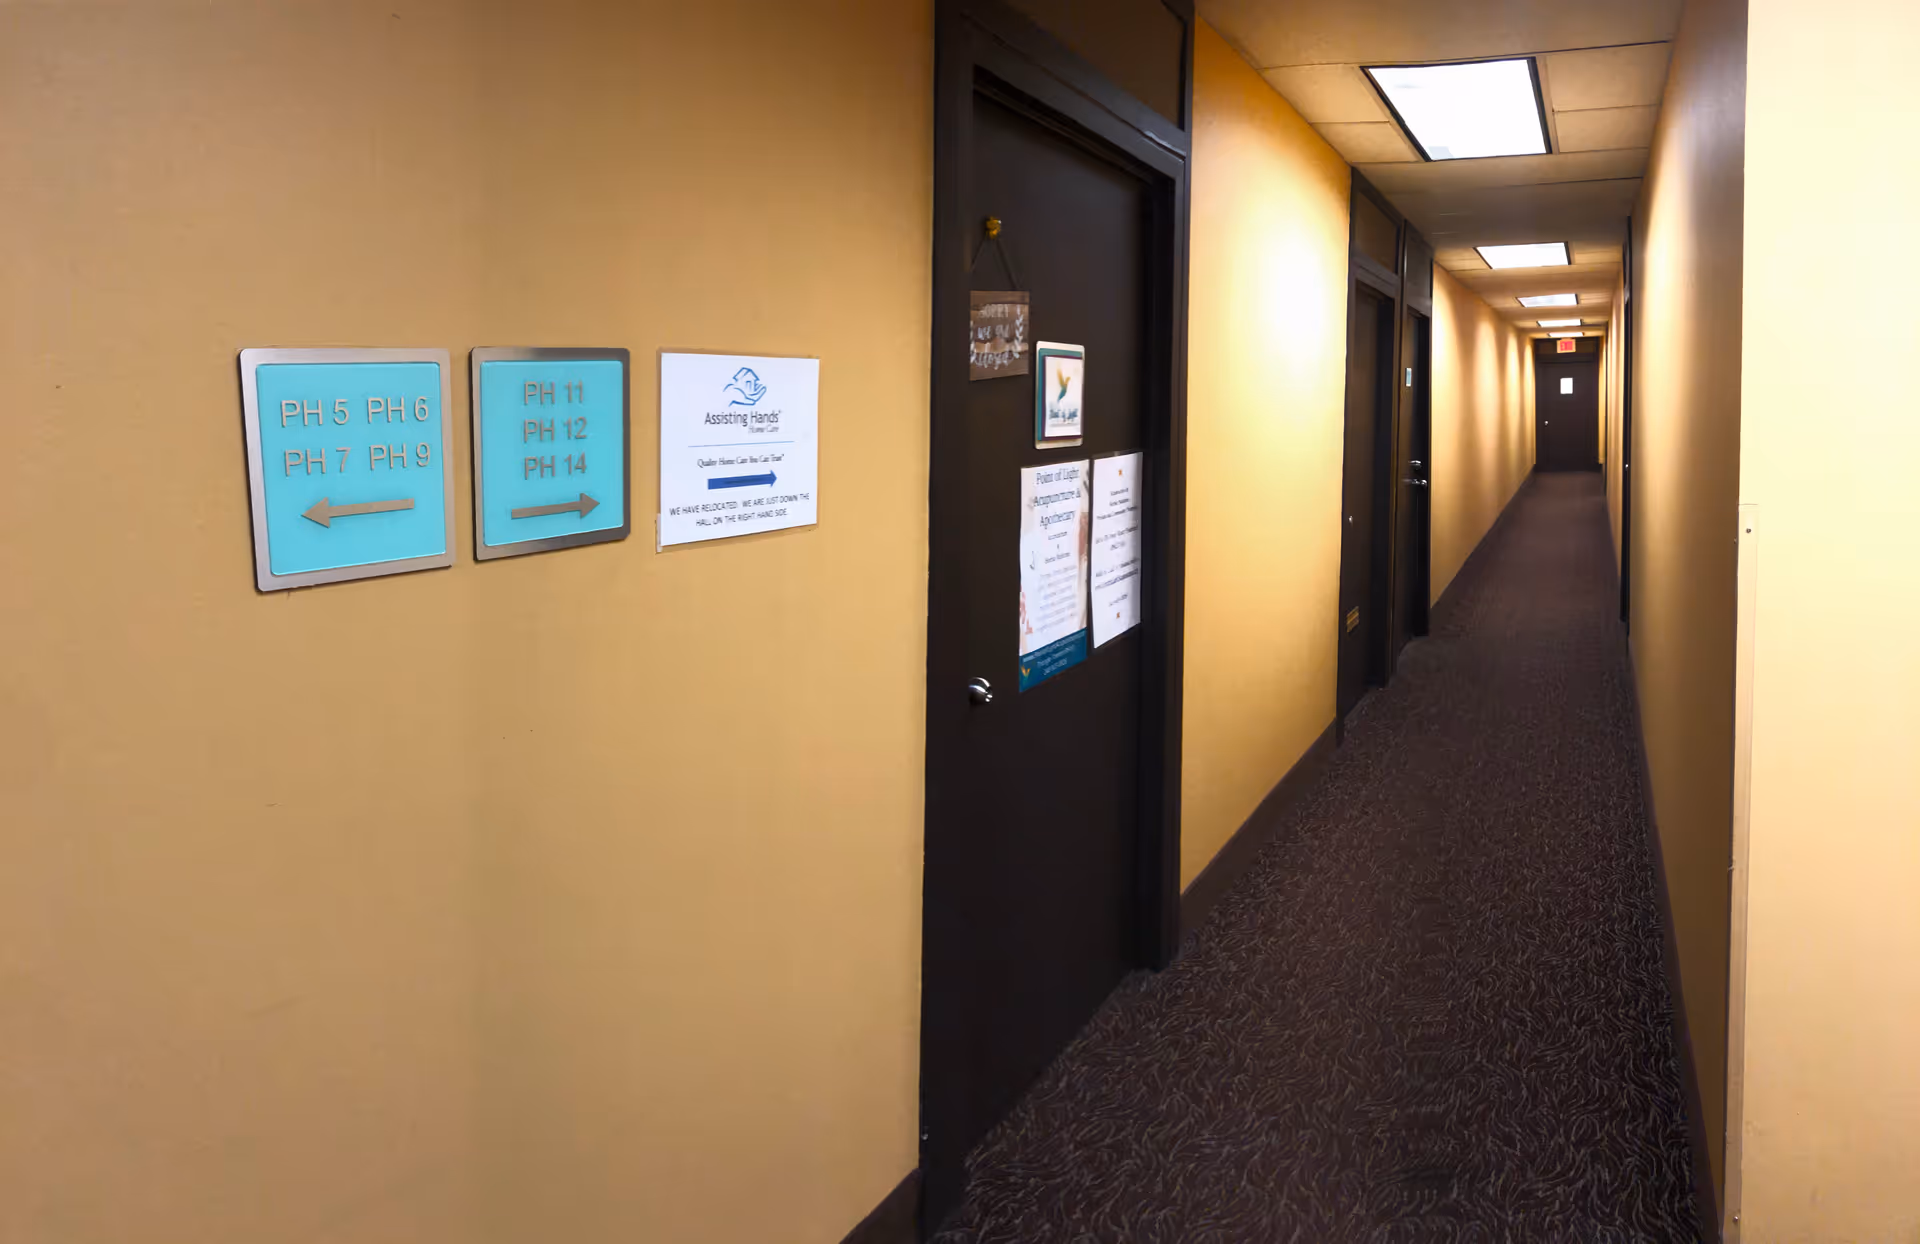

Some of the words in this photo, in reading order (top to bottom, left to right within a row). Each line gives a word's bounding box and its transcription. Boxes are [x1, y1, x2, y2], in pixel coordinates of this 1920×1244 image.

[523, 380, 556, 406] PH
[564, 380, 585, 405] 11
[280, 399, 324, 428] PH
[332, 400, 350, 425] 5
[367, 396, 405, 423] PH
[414, 395, 430, 421] 6
[704, 411, 748, 427] Assisting
[523, 418, 556, 443] PH
[563, 416, 588, 440] 12
[284, 448, 327, 477] PH
[336, 447, 352, 474] 7
[369, 443, 408, 471] PH
[416, 442, 431, 468] 9
[523, 455, 556, 481] PH
[563, 452, 588, 476] 14
[669, 506, 681, 516] WE
[682, 504, 700, 514] HAVE
[742, 499, 752, 508] WE
[753, 497, 765, 506] ARE
[765, 496, 779, 505] JUST
[780, 494, 798, 504] DOWN
[799, 492, 810, 501] THE
[696, 517, 712, 527] HALL
[713, 516, 723, 525] ON
[725, 514, 737, 524] THE
[738, 512, 756, 522] RIGHT
[757, 510, 774, 519] HAND
